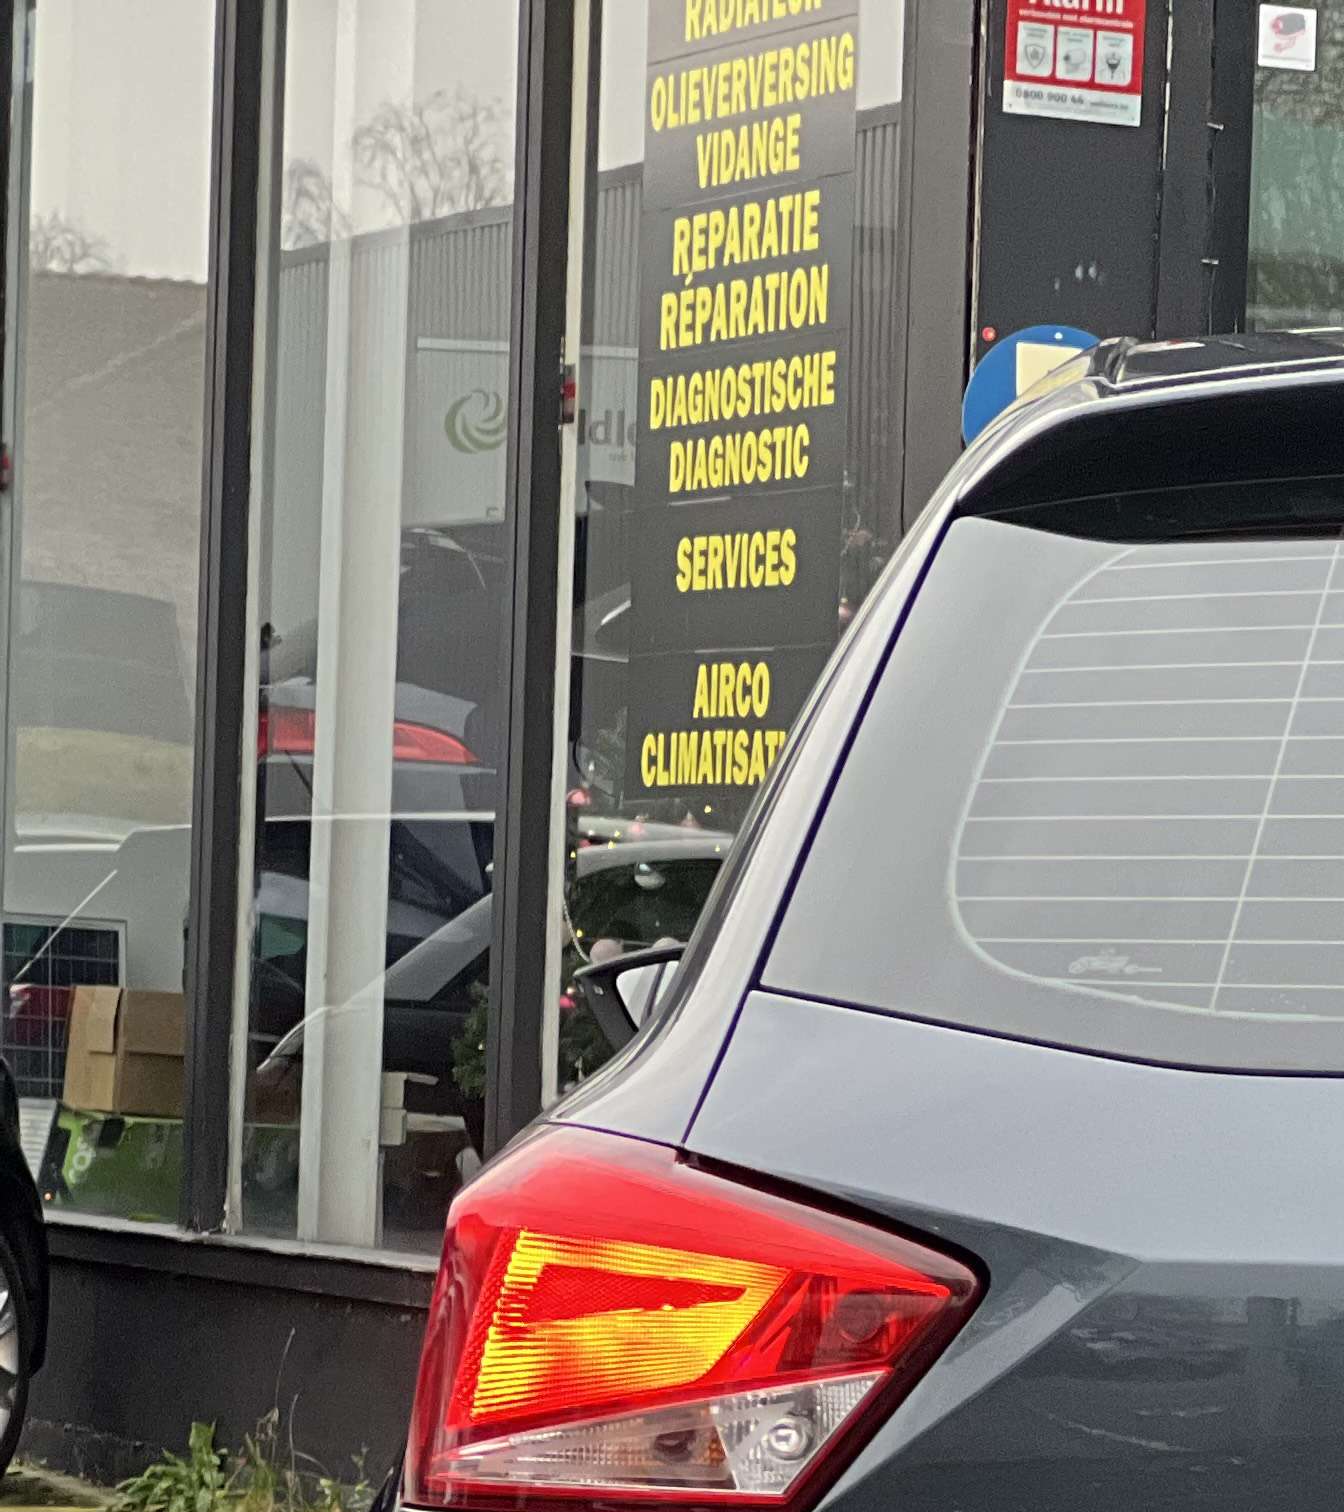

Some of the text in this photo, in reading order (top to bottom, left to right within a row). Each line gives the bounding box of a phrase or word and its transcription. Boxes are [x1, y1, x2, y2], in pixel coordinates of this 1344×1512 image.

[650, 32, 854, 132] OLIEVERVERSING
[696, 113, 801, 189] VIDANGE
[672, 189, 820, 277] REPARATIE
[660, 263, 829, 351] RÉPARATION
[650, 350, 836, 430] DIAGNOSTISCHE
[669, 423, 810, 493] DIAGNOSTIC
[675, 528, 797, 593] SERVICES
[693, 661, 770, 719] AIRCO
